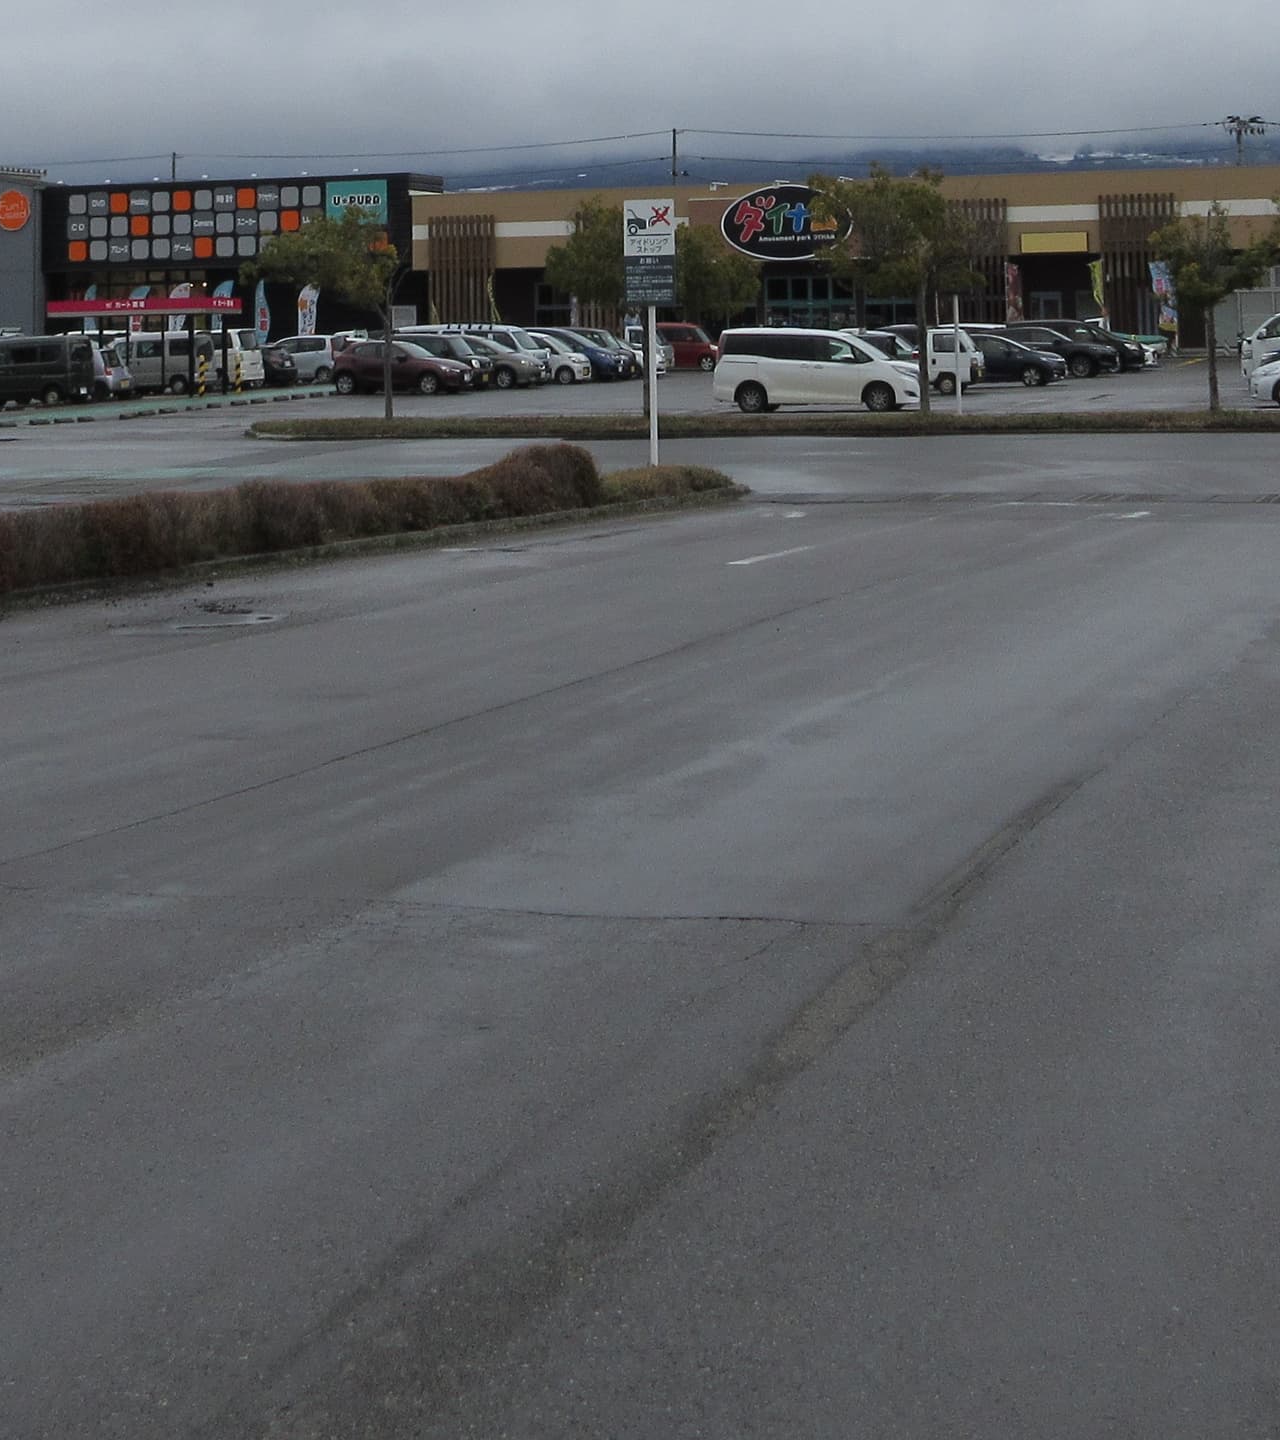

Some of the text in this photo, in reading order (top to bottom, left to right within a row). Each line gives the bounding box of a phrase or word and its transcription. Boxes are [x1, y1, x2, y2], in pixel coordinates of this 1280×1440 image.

[630, 238, 669, 246] アイドリング
[636, 246, 662, 254] ストップ
